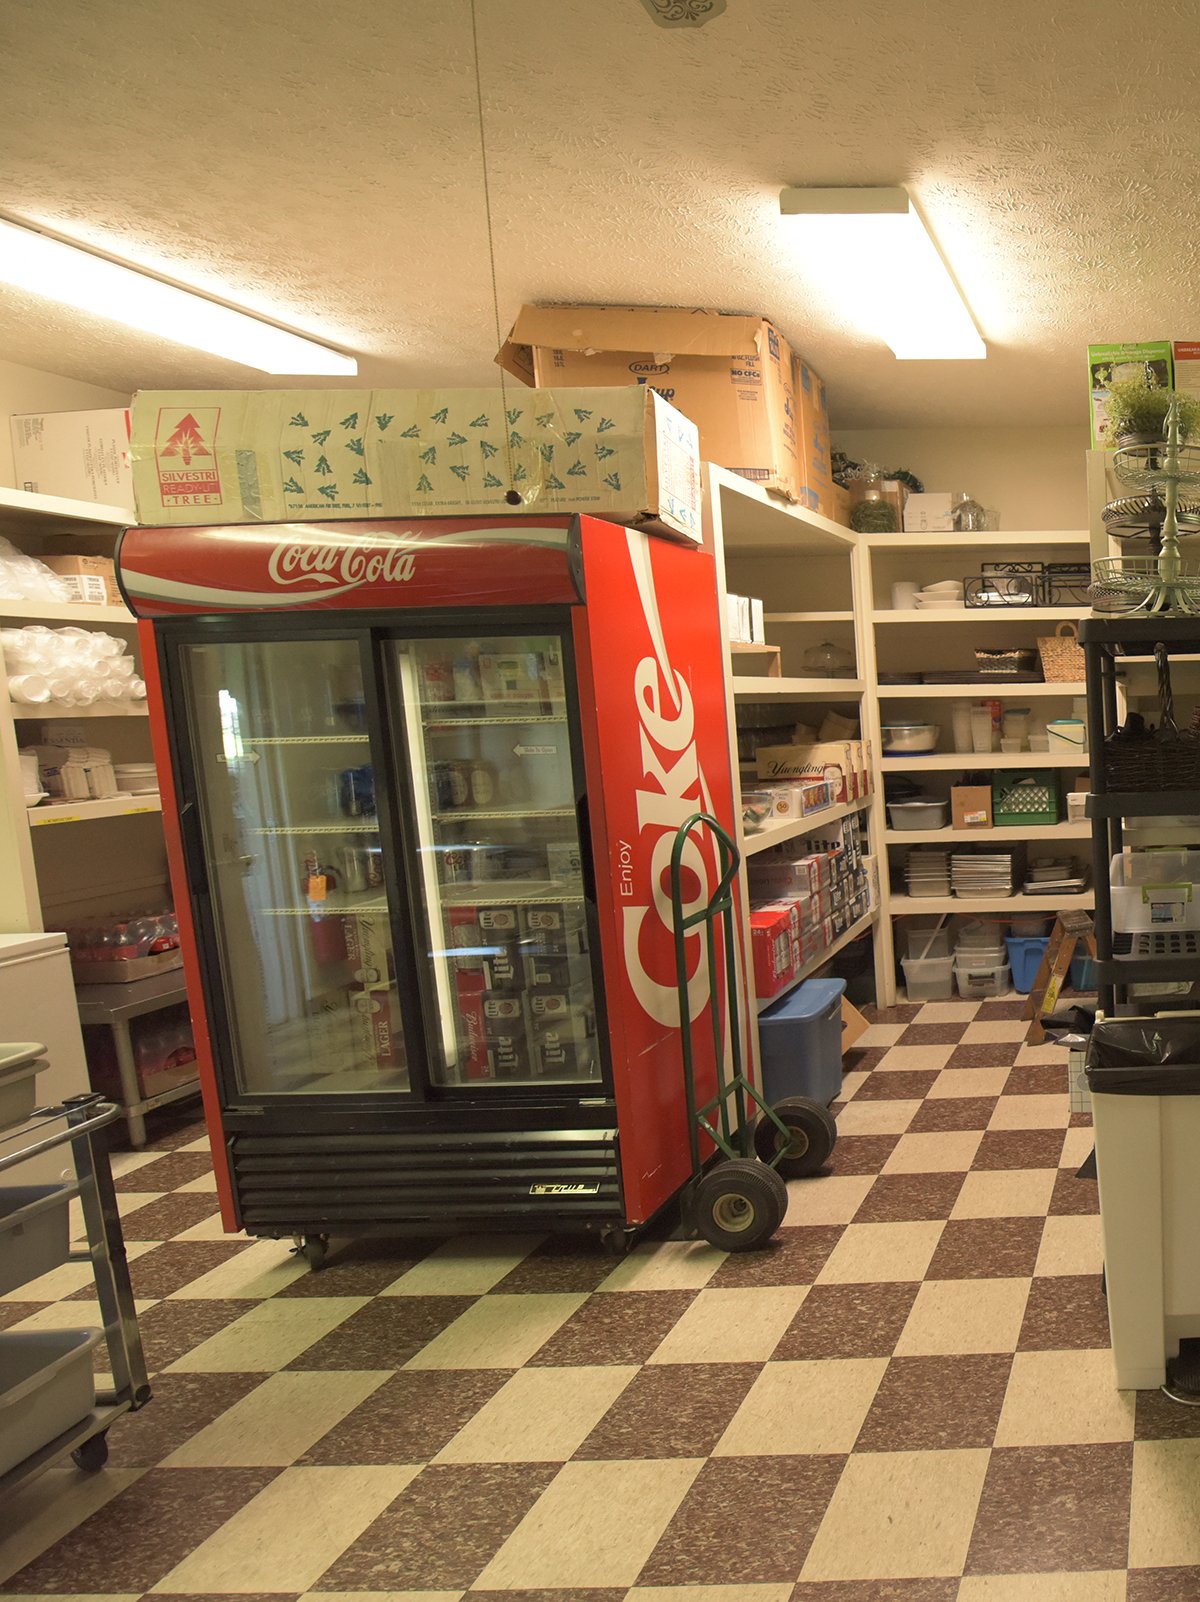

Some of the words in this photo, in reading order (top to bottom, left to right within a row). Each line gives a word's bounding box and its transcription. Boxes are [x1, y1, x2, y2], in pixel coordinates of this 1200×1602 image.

[633, 362, 665, 373] DART
[162, 471, 216, 482] SILVESTRI
[173, 495, 211, 505] TREE
[767, 760, 824, 777] Yuengling
[620, 839, 634, 897] Enjoy
[344, 923, 357, 961] LAGER
[378, 1020, 392, 1057] LAGER
[465, 1010, 478, 1062] Budweiser
[544, 1032, 566, 1064] Lite
